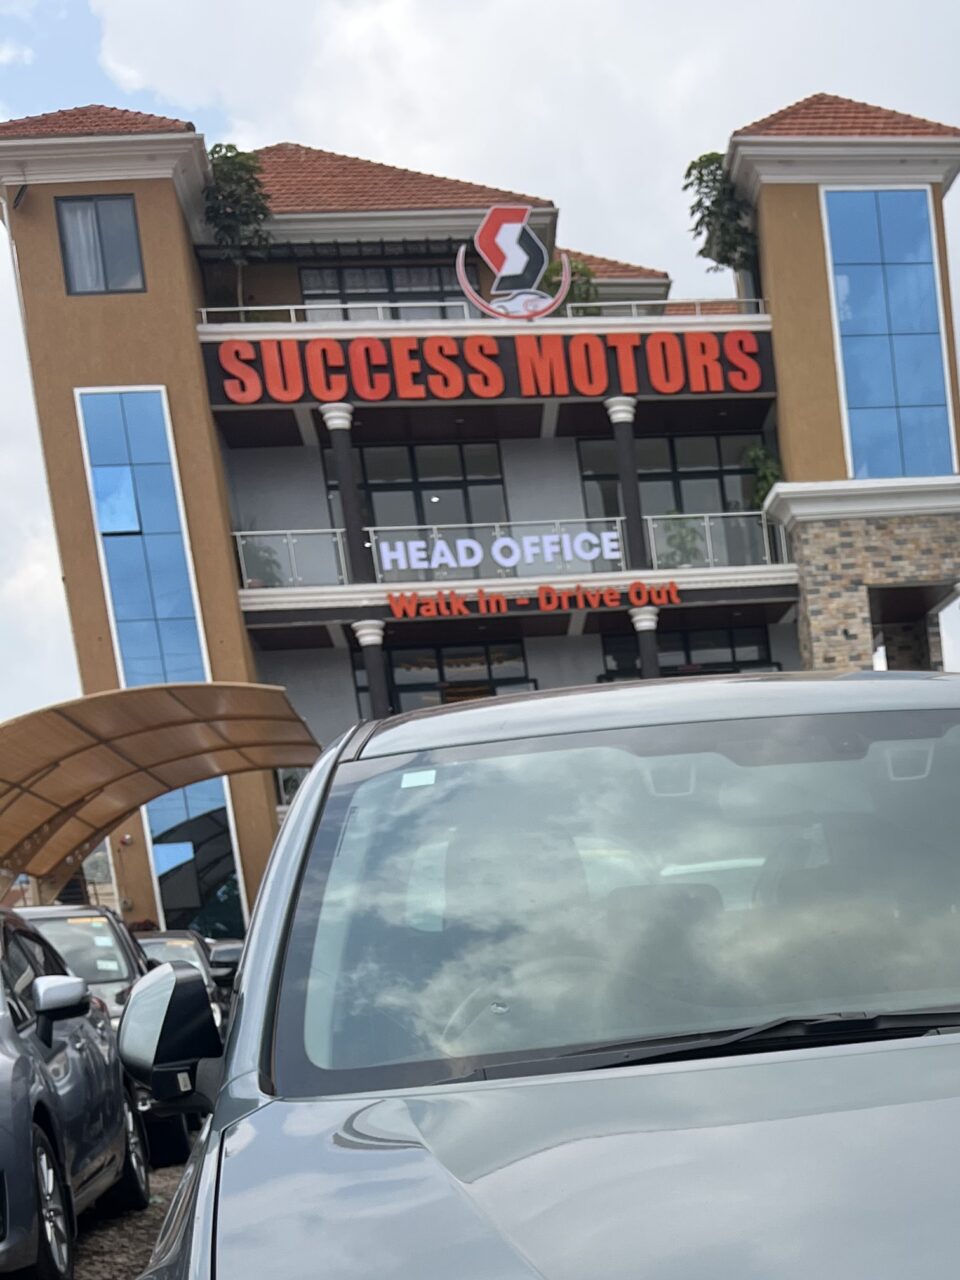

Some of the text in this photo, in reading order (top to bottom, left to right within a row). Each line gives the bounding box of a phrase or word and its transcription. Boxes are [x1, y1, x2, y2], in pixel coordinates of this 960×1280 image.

[218, 330, 762, 404] SUCCESS MOTORS
[380, 531, 621, 571] HEAD OFFICE
[387, 590, 470, 619] Walk
[537, 584, 621, 612] Drive
[627, 581, 682, 607] Out
